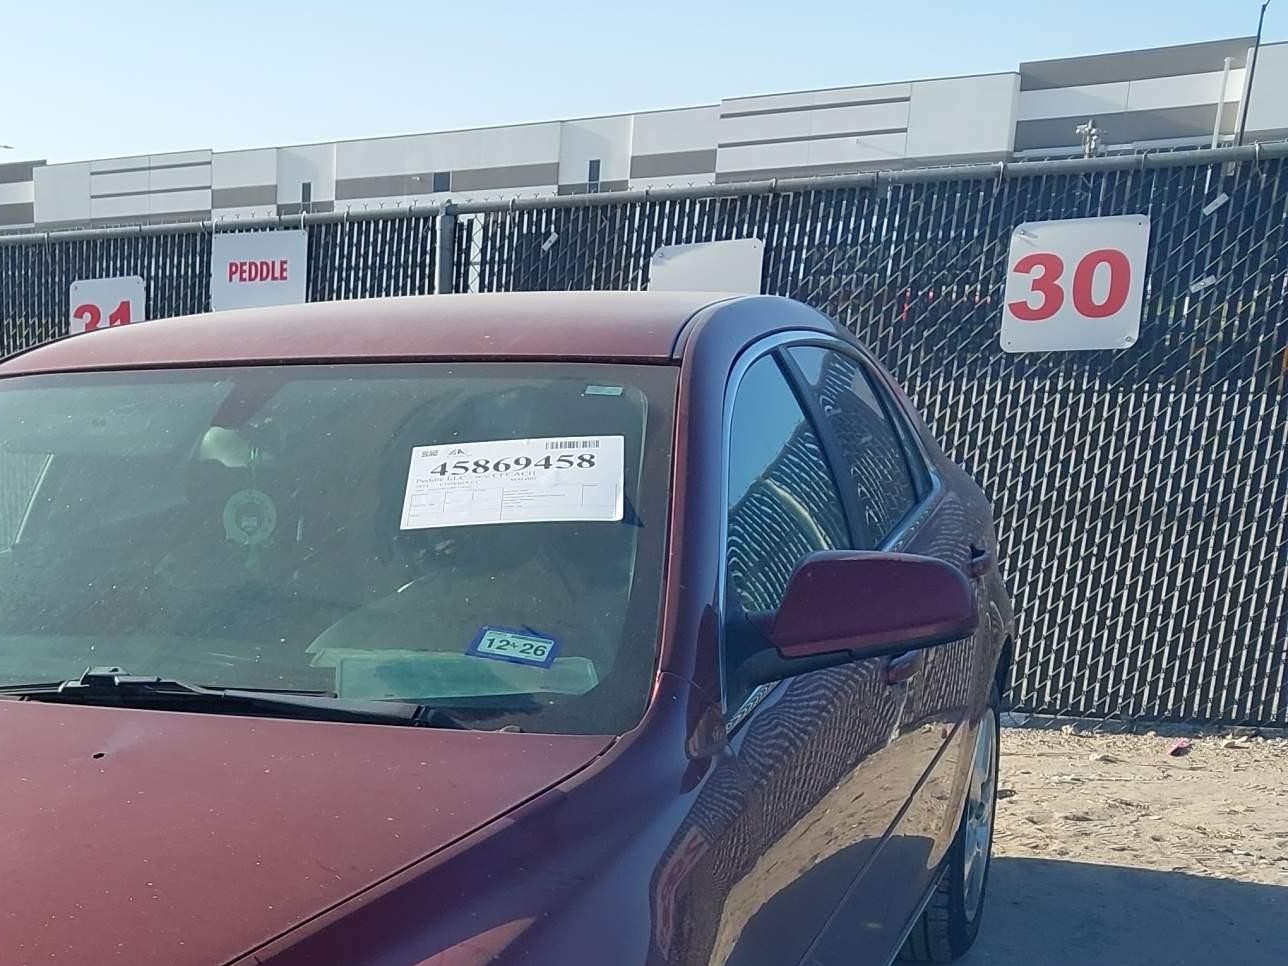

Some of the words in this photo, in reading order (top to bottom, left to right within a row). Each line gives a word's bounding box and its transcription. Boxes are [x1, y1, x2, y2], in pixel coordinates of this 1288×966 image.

[228, 260, 288, 283] PEDDLE
[1007, 248, 1132, 322] 30
[430, 453, 596, 477] 45869458
[486, 637, 511, 651] 12
[519, 642, 548, 657] 26
